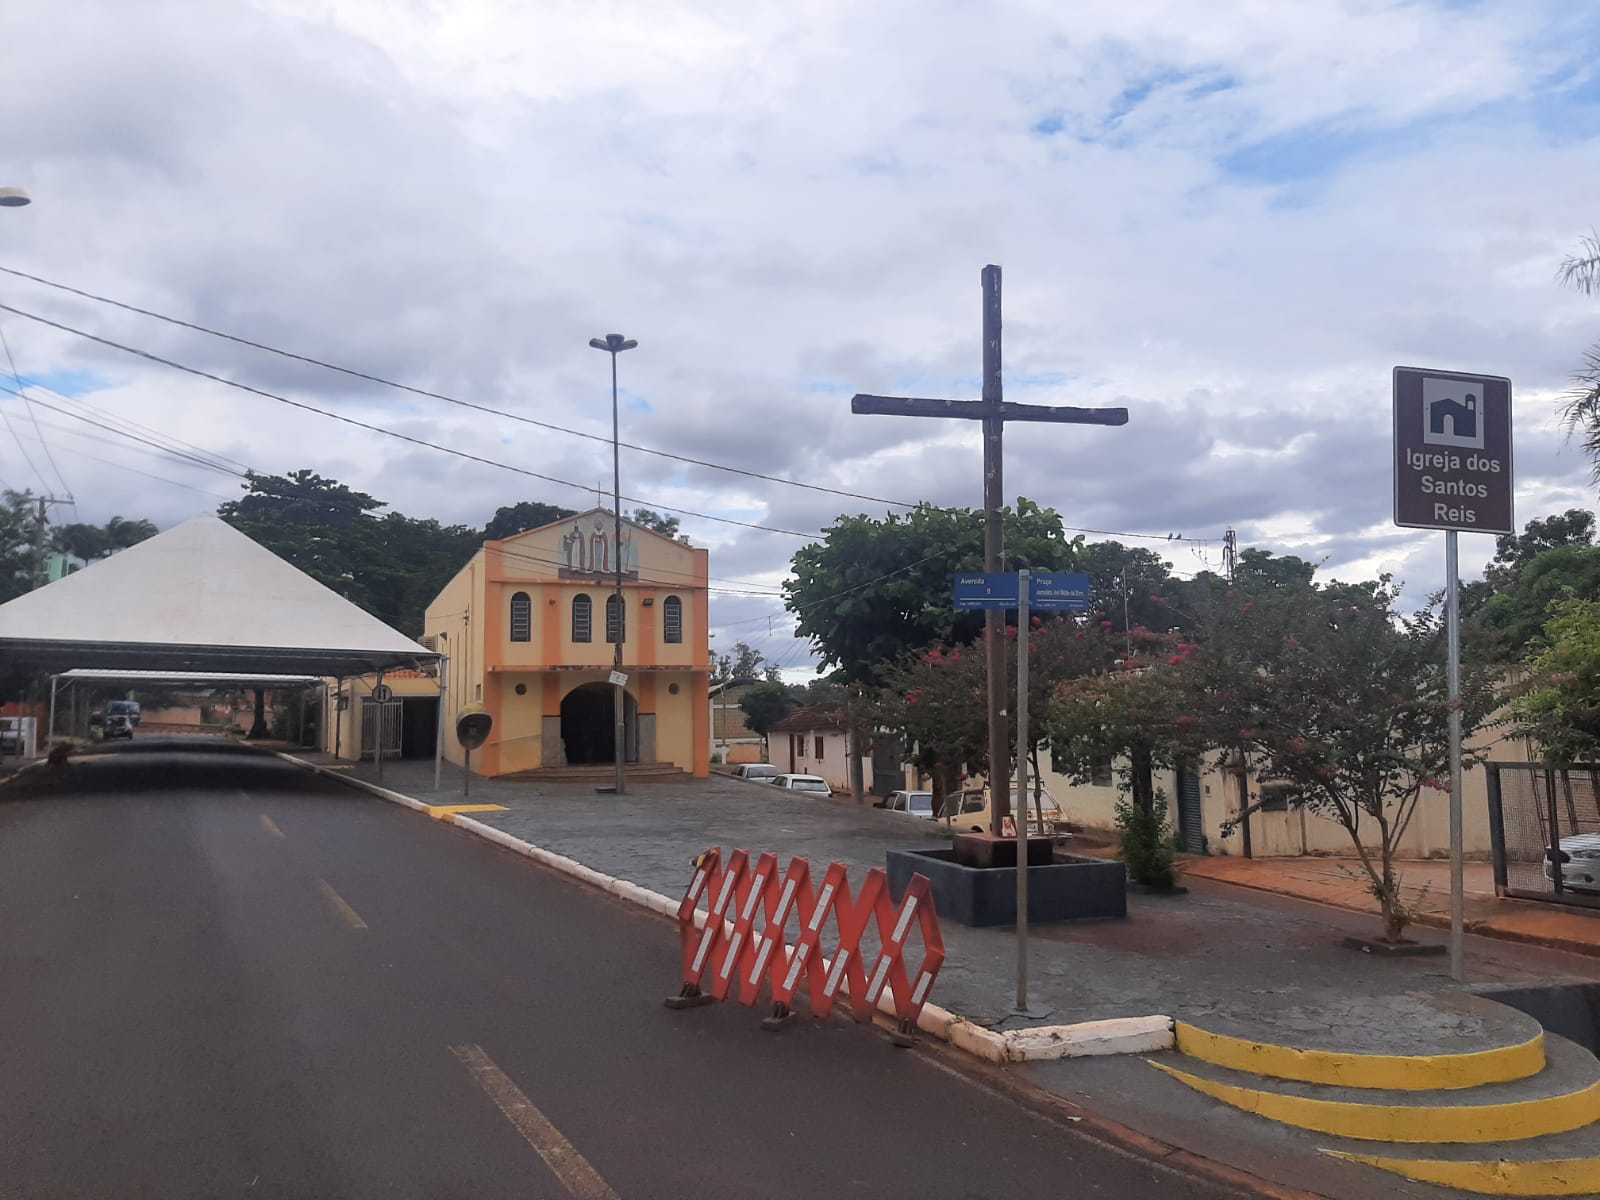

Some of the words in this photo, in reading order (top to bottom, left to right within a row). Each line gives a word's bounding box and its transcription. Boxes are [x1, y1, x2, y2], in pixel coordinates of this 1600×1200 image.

[1406, 447, 1461, 472] Igreja
[1466, 454, 1501, 473] dos
[1420, 475, 1488, 498] Santos
[1434, 502, 1477, 523] Reis
[960, 577, 985, 585] Avenida
[1036, 577, 1052, 586] Praça
